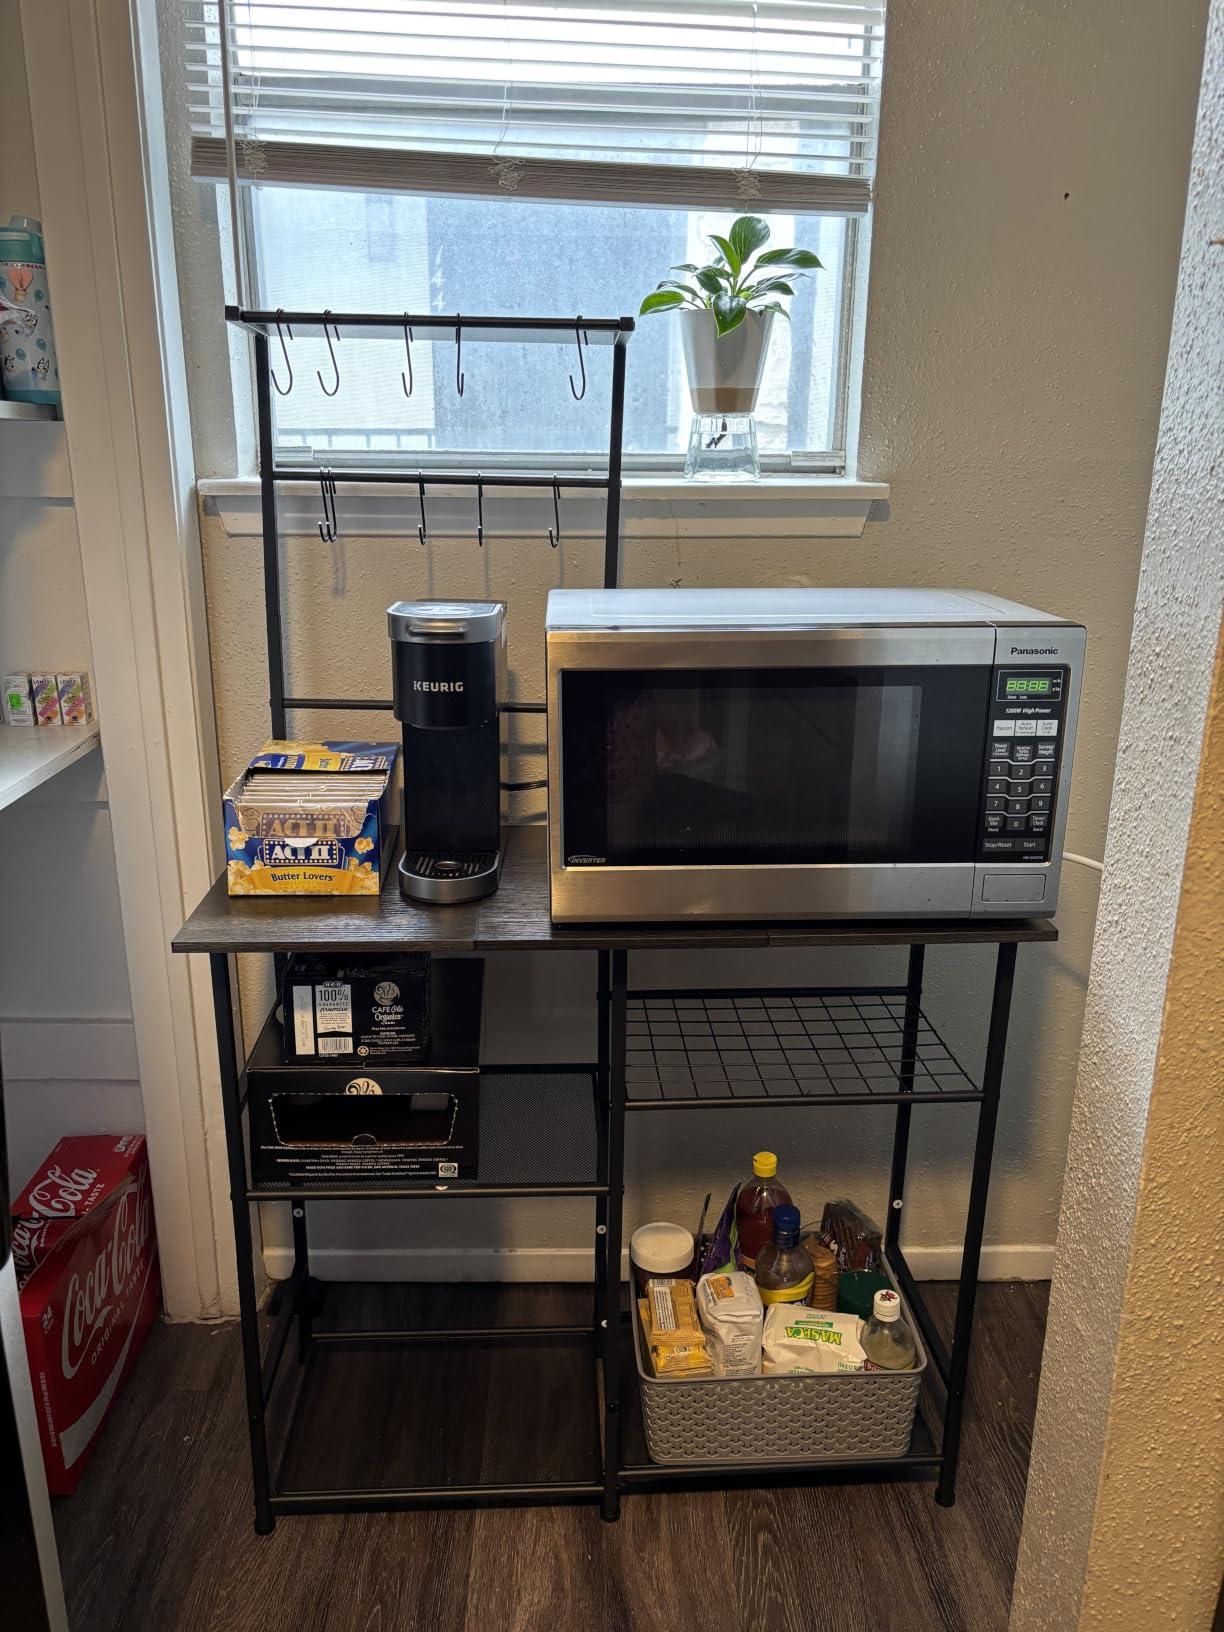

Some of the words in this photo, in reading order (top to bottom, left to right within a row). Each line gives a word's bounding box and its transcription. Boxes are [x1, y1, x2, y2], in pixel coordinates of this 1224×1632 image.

[1011, 647, 1058, 655] Panasonic
[413, 681, 464, 692] KEURIG
[268, 819, 311, 837] ACT
[271, 845, 306, 860] ACT
[310, 845, 331, 860] II
[270, 873, 300, 882] Butter
[303, 872, 333, 882] Lovers
[319, 989, 349, 1002] 100%
[84, 1183, 105, 1206] TASTE
[91, 1301, 125, 1365] ORIGINAL
[785, 1327, 842, 1345] MASECA
